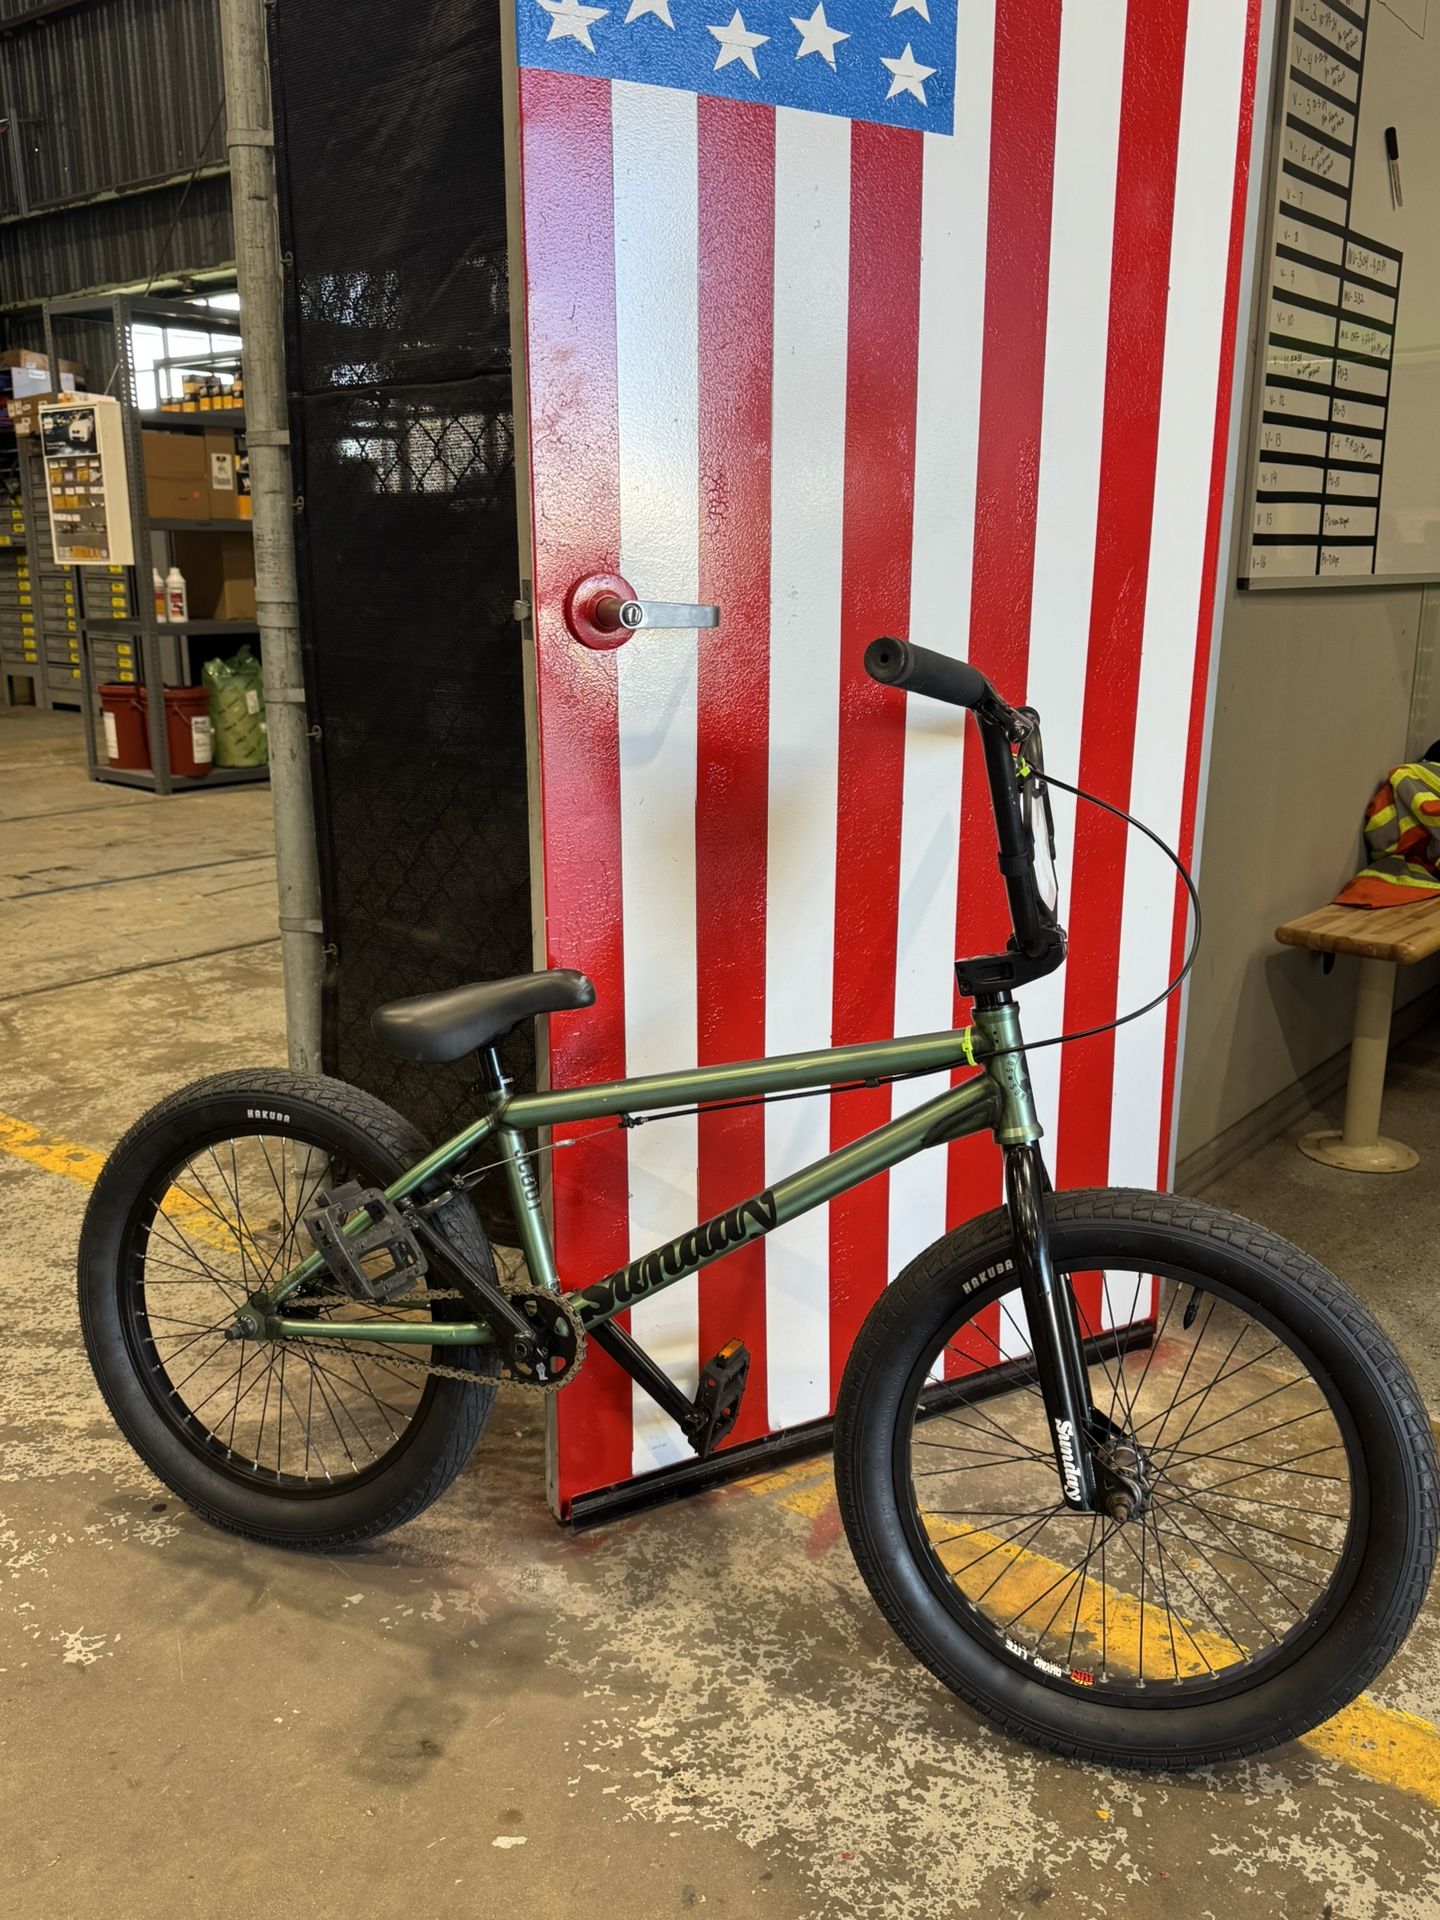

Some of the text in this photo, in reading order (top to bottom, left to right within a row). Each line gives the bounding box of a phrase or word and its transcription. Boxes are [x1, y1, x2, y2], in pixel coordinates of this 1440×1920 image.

[247, 1109, 291, 1124] HAKUBA
[962, 1258, 1014, 1295] HAKUBA
[1054, 1418, 1082, 1502] Sunday
[1004, 1639, 1028, 1660] LITE
